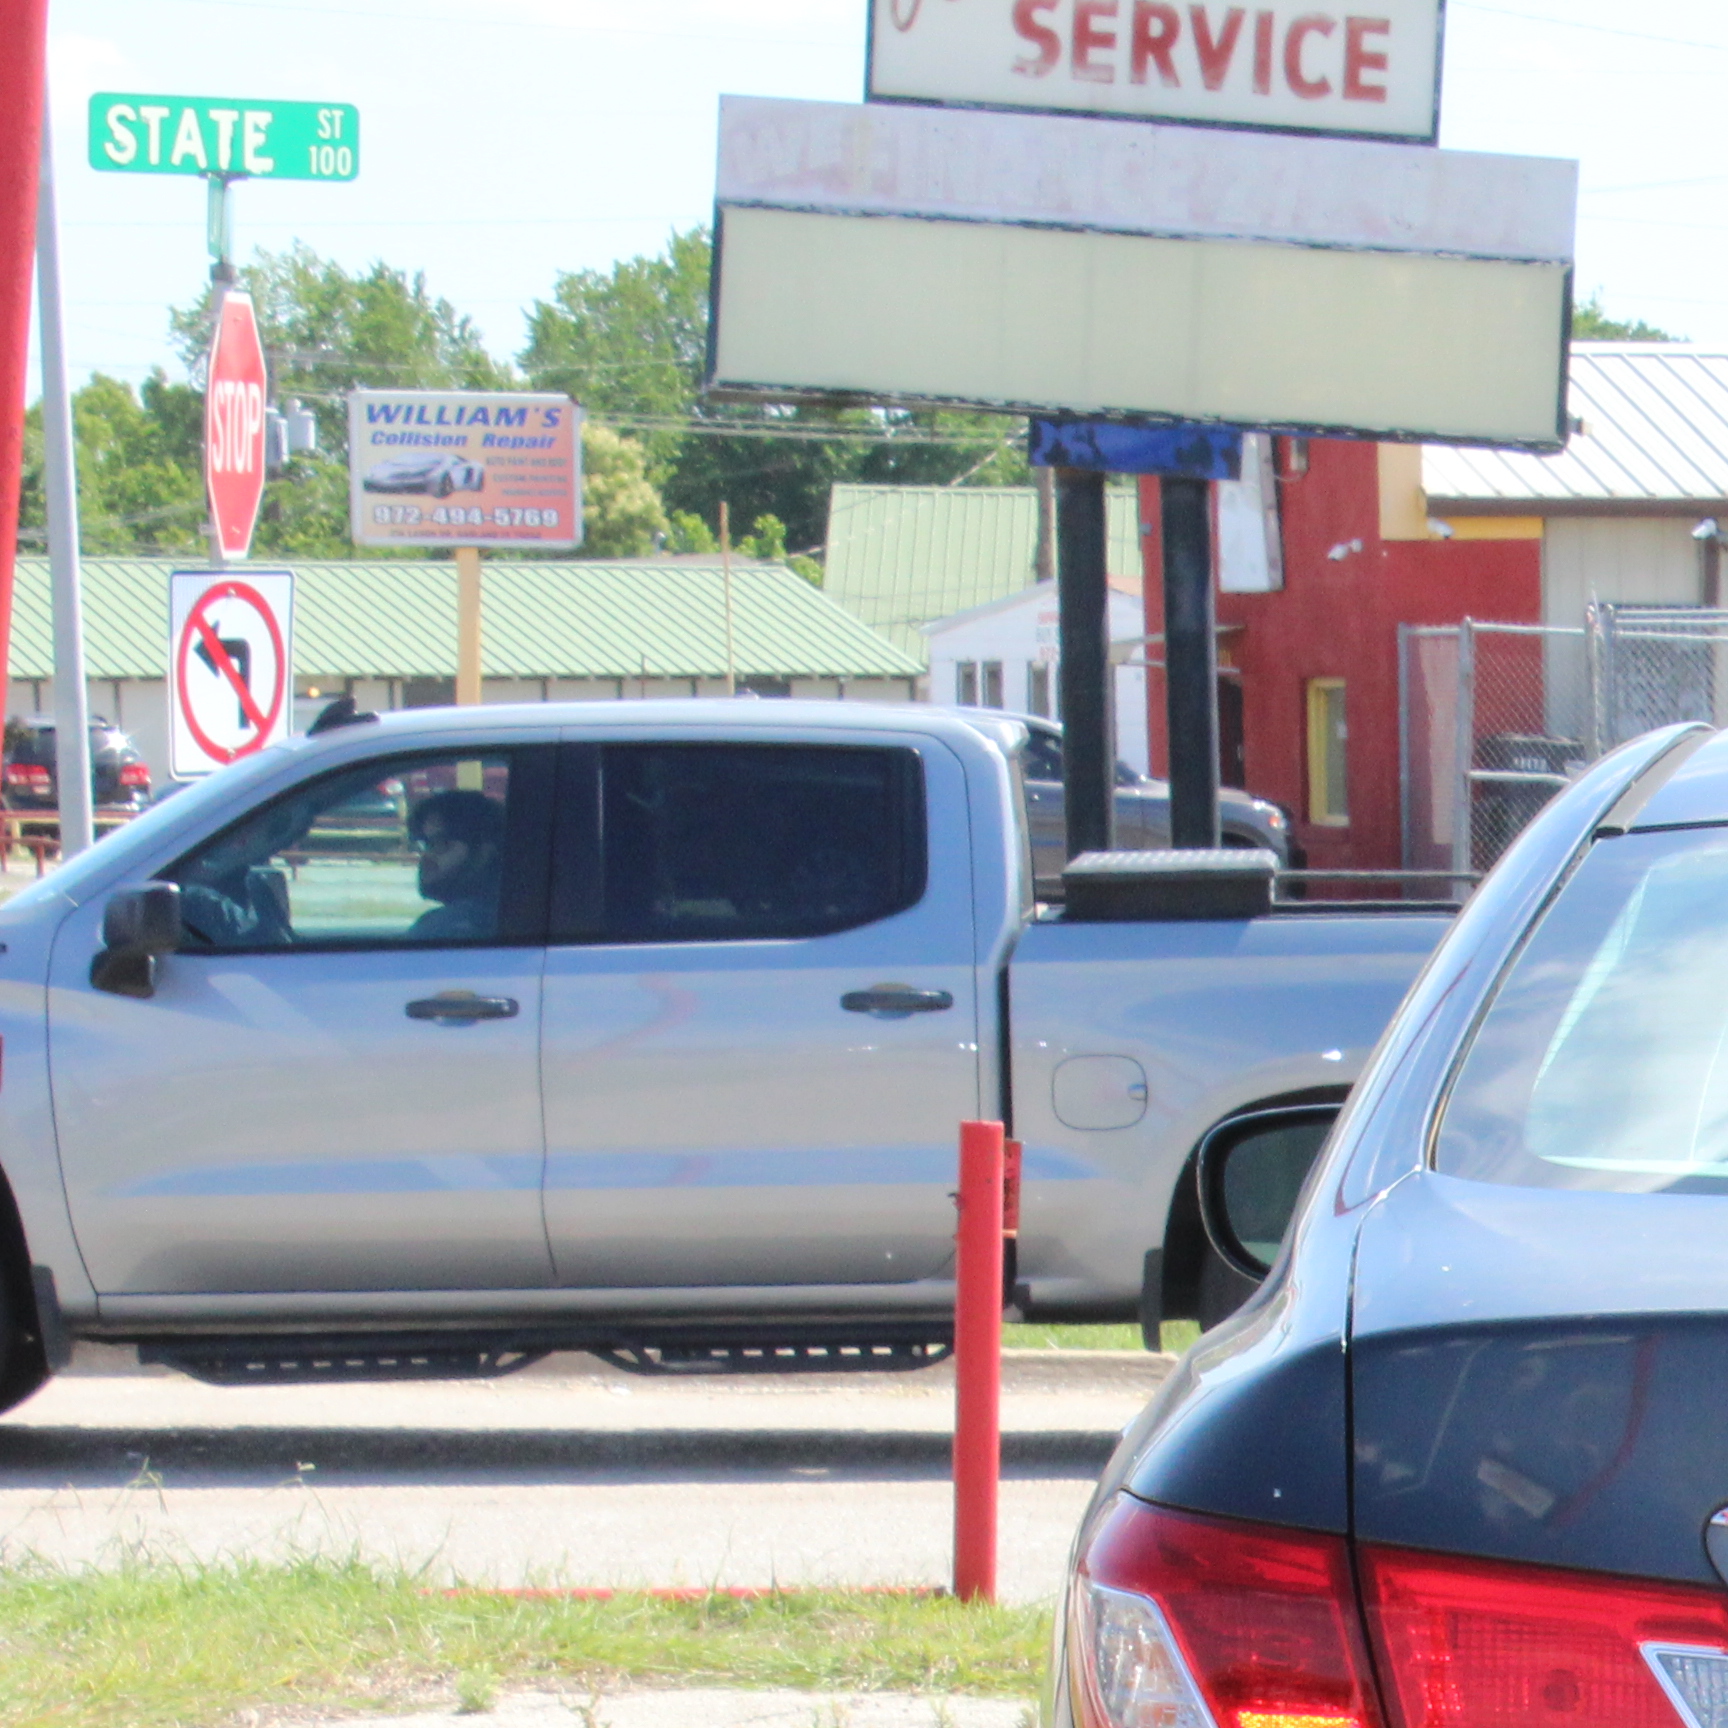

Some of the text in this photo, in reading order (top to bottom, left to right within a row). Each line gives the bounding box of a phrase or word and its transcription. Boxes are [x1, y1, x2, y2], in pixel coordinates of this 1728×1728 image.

[1011, 0, 1391, 103] SERVICE
[104, 103, 275, 175] STATE
[317, 109, 345, 140] ST
[309, 145, 353, 177] 100
[212, 381, 261, 474] STOP
[366, 404, 562, 428] WILLIAM'S
[370, 430, 557, 449] Collision Repair
[373, 505, 560, 527] 972-494-5769
